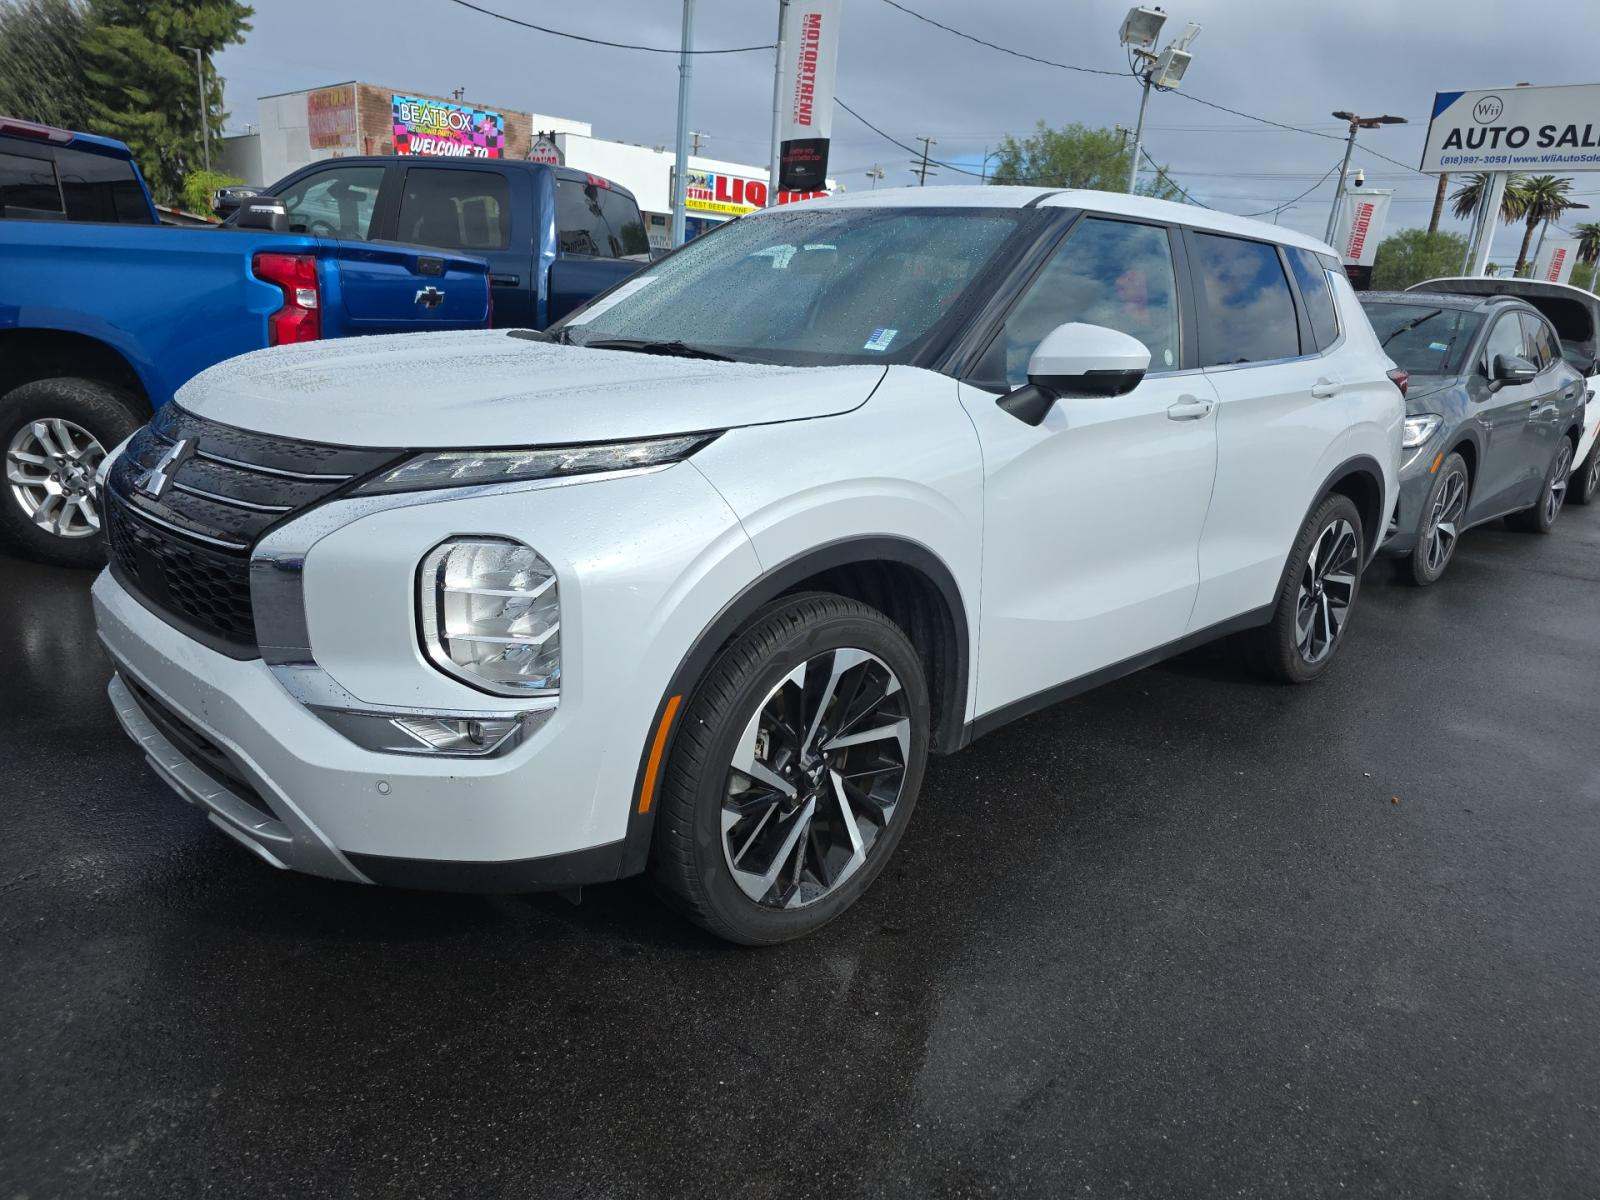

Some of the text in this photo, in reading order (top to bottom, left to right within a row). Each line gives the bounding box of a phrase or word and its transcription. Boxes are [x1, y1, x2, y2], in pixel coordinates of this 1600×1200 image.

[798, 13, 822, 126] MOTORTREND
[400, 103, 472, 132] BEATBOX
[1478, 103, 1500, 116] Wii
[410, 136, 472, 157] WELCOME
[473, 147, 489, 158] TO
[1441, 124, 1600, 150] AUTO SAL
[1350, 203, 1374, 259] MOTORTREND
